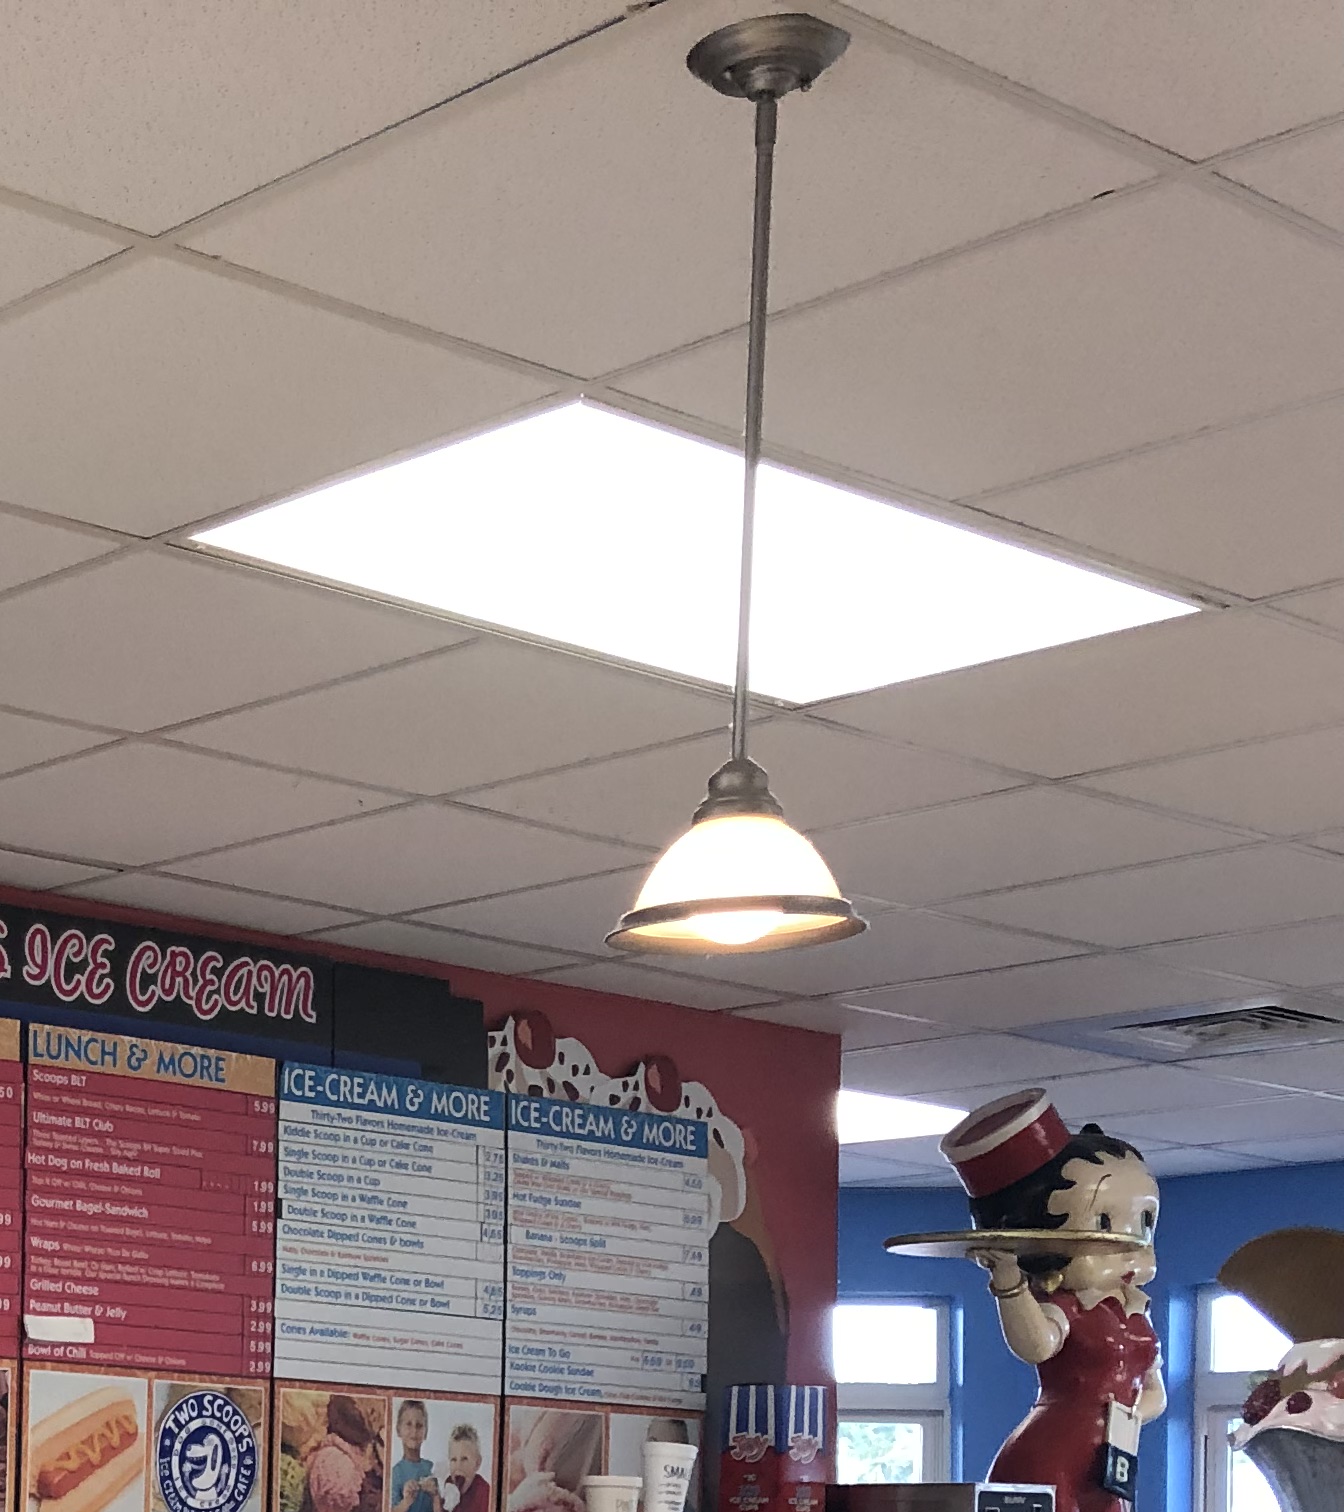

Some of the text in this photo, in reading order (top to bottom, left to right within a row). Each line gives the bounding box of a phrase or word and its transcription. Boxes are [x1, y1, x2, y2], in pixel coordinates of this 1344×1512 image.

[23, 923, 115, 1004] ICE
[126, 940, 318, 1024] CREAM
[32, 1030, 227, 1084] LUNCH & MORE
[32, 1068, 86, 1088] Scoops BLT
[284, 1068, 491, 1122] ICE-CREAM & MORE
[511, 1100, 697, 1152] ICE-CREAM & MORE
[166, 1395, 252, 1452] TWO SCOOPS
[234, 1468, 251, 1501] CAFE
